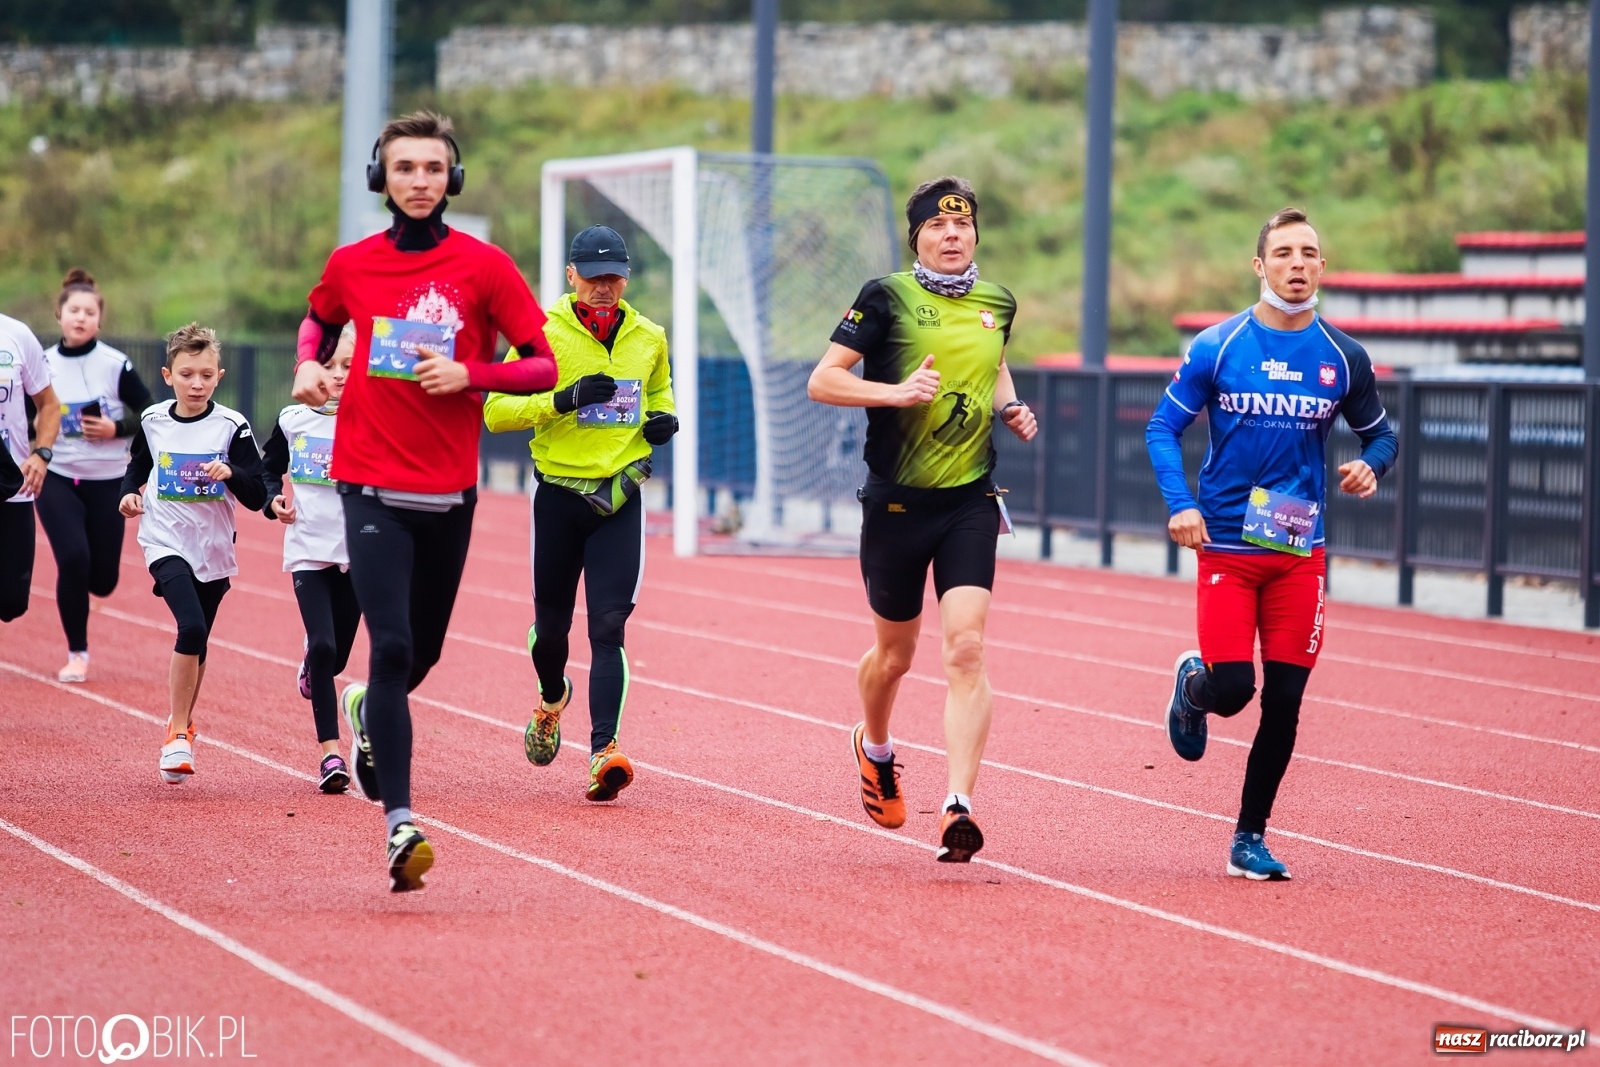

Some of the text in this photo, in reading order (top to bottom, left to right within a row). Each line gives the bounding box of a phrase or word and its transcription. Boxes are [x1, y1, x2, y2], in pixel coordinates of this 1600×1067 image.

[947, 380, 973, 390] GRUPA
[616, 413, 635, 424] 229
[194, 484, 218, 495] 056
[1274, 512, 1288, 521] DLA
[1288, 534, 1307, 548] 110
[1306, 575, 1324, 654] POLSKA
